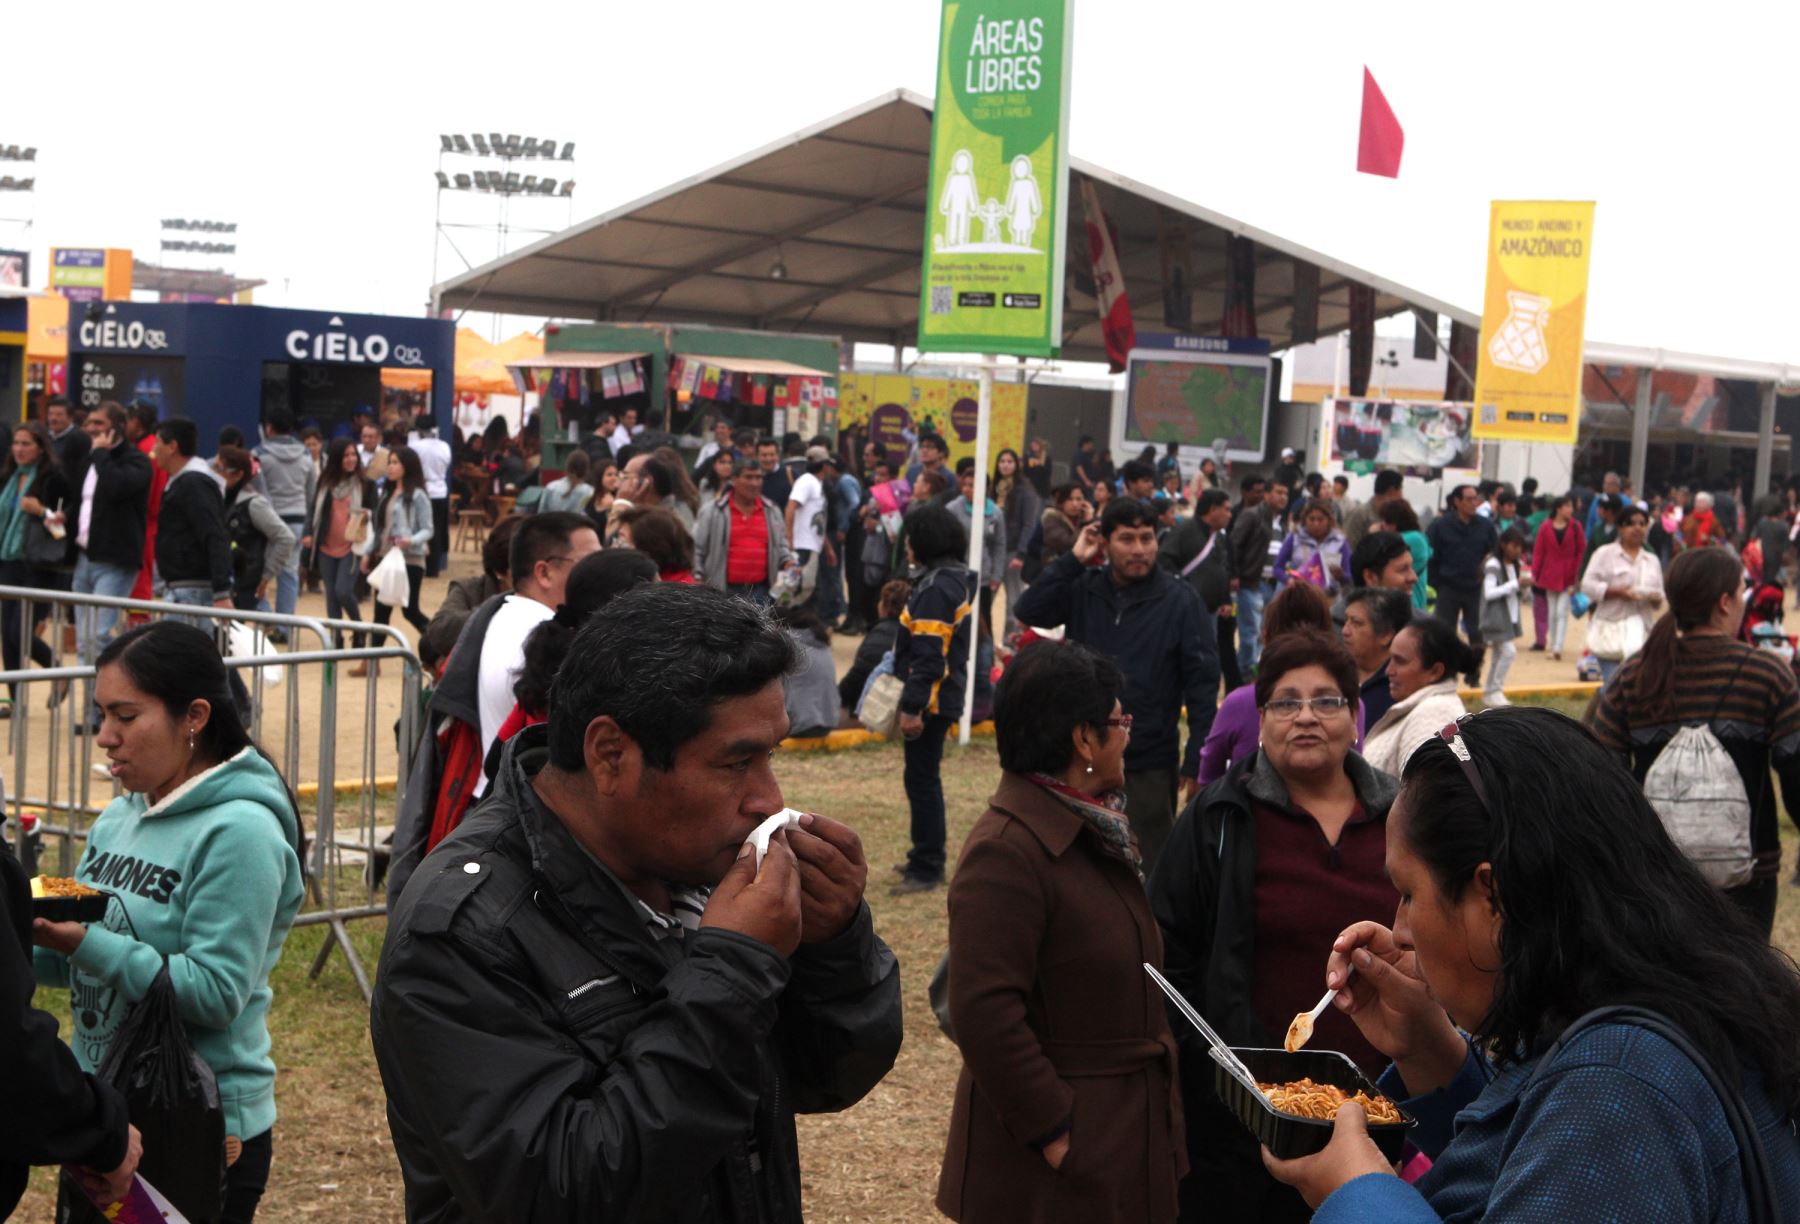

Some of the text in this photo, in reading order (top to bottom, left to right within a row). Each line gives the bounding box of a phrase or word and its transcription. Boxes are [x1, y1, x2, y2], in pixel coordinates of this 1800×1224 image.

[969, 14, 1044, 57] ÁREAS
[965, 55, 1042, 93] LIBRES
[1499, 234, 1582, 258] AMAZÓNICO
[80, 319, 144, 349] CIELO
[285, 329, 389, 363] CIELO
[1174, 336, 1230, 352] SAMSUNG
[81, 372, 115, 390] CIELO
